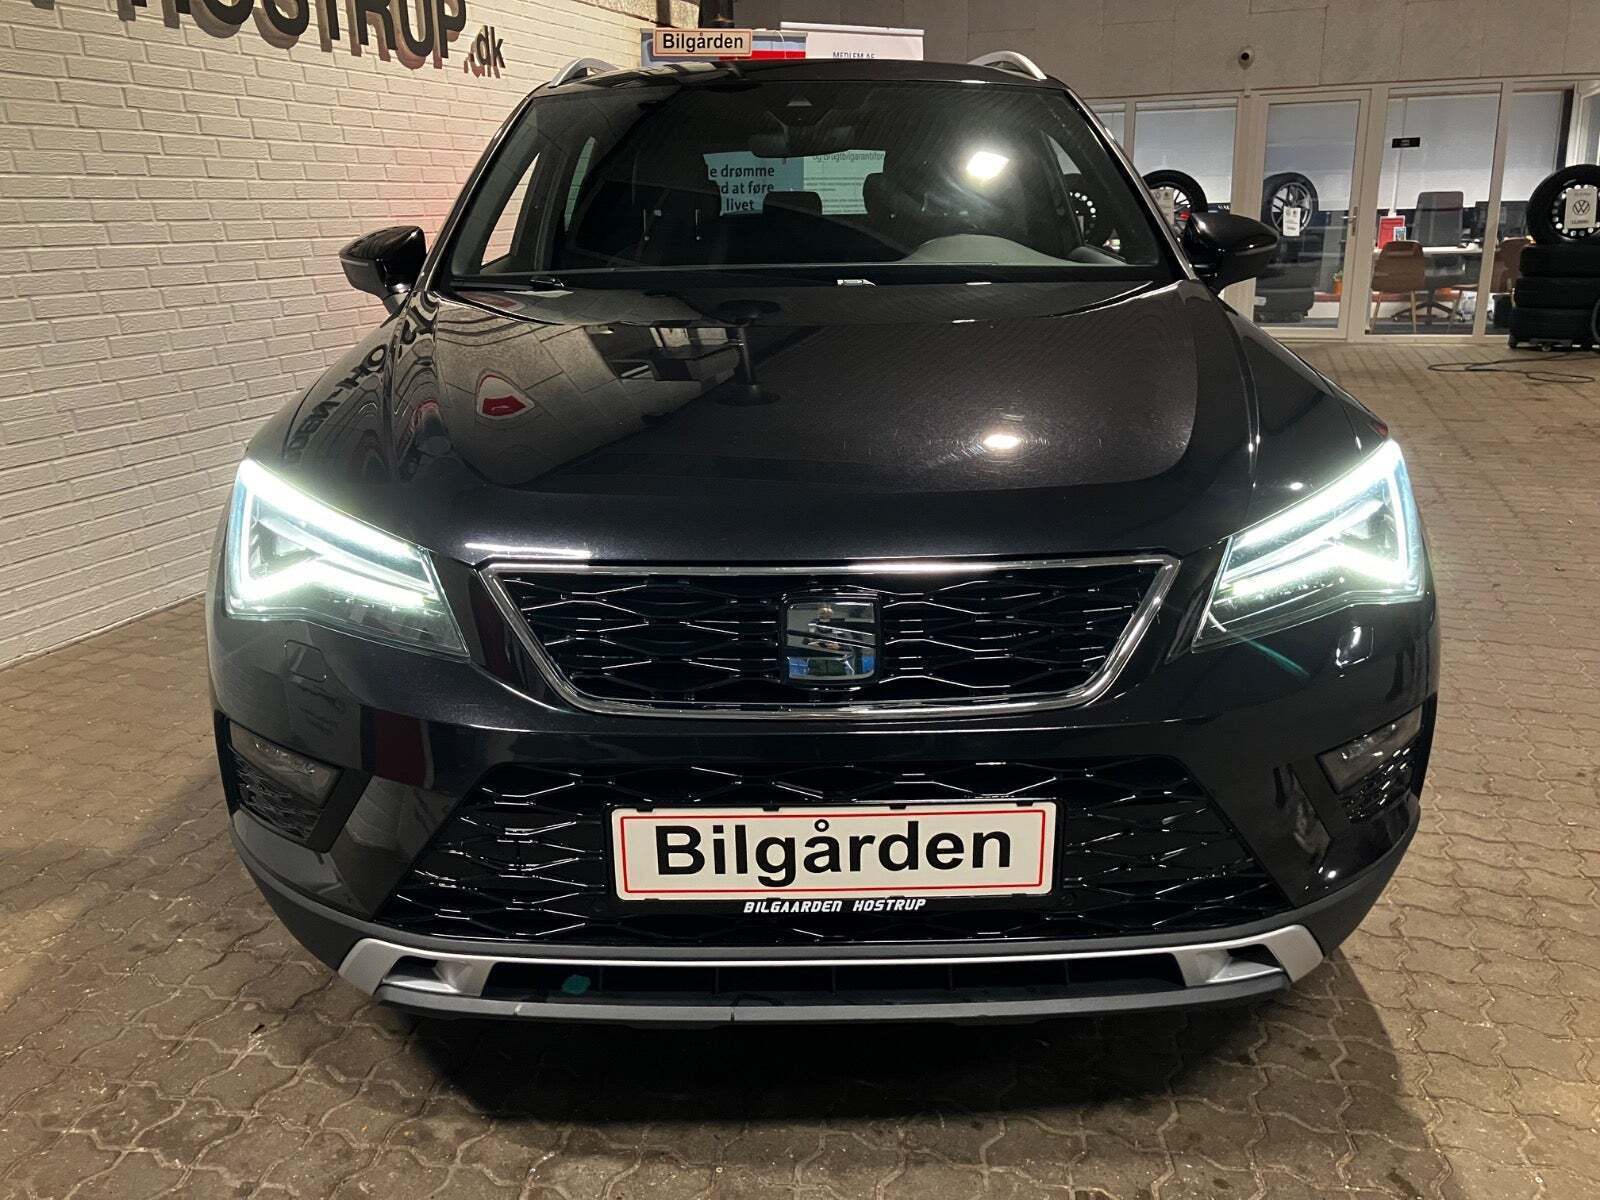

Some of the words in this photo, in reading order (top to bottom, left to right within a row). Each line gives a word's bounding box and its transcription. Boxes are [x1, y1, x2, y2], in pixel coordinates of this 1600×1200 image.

[662, 31, 744, 53] Bilgården
[720, 164, 775, 177] drømme
[732, 182, 744, 194] at
[748, 181, 774, 194] føre
[726, 198, 754, 211] livet
[654, 819, 1012, 889] Bilgården
[743, 899, 842, 914] BILGAARDEN
[852, 898, 926, 912] HOSTRUP
